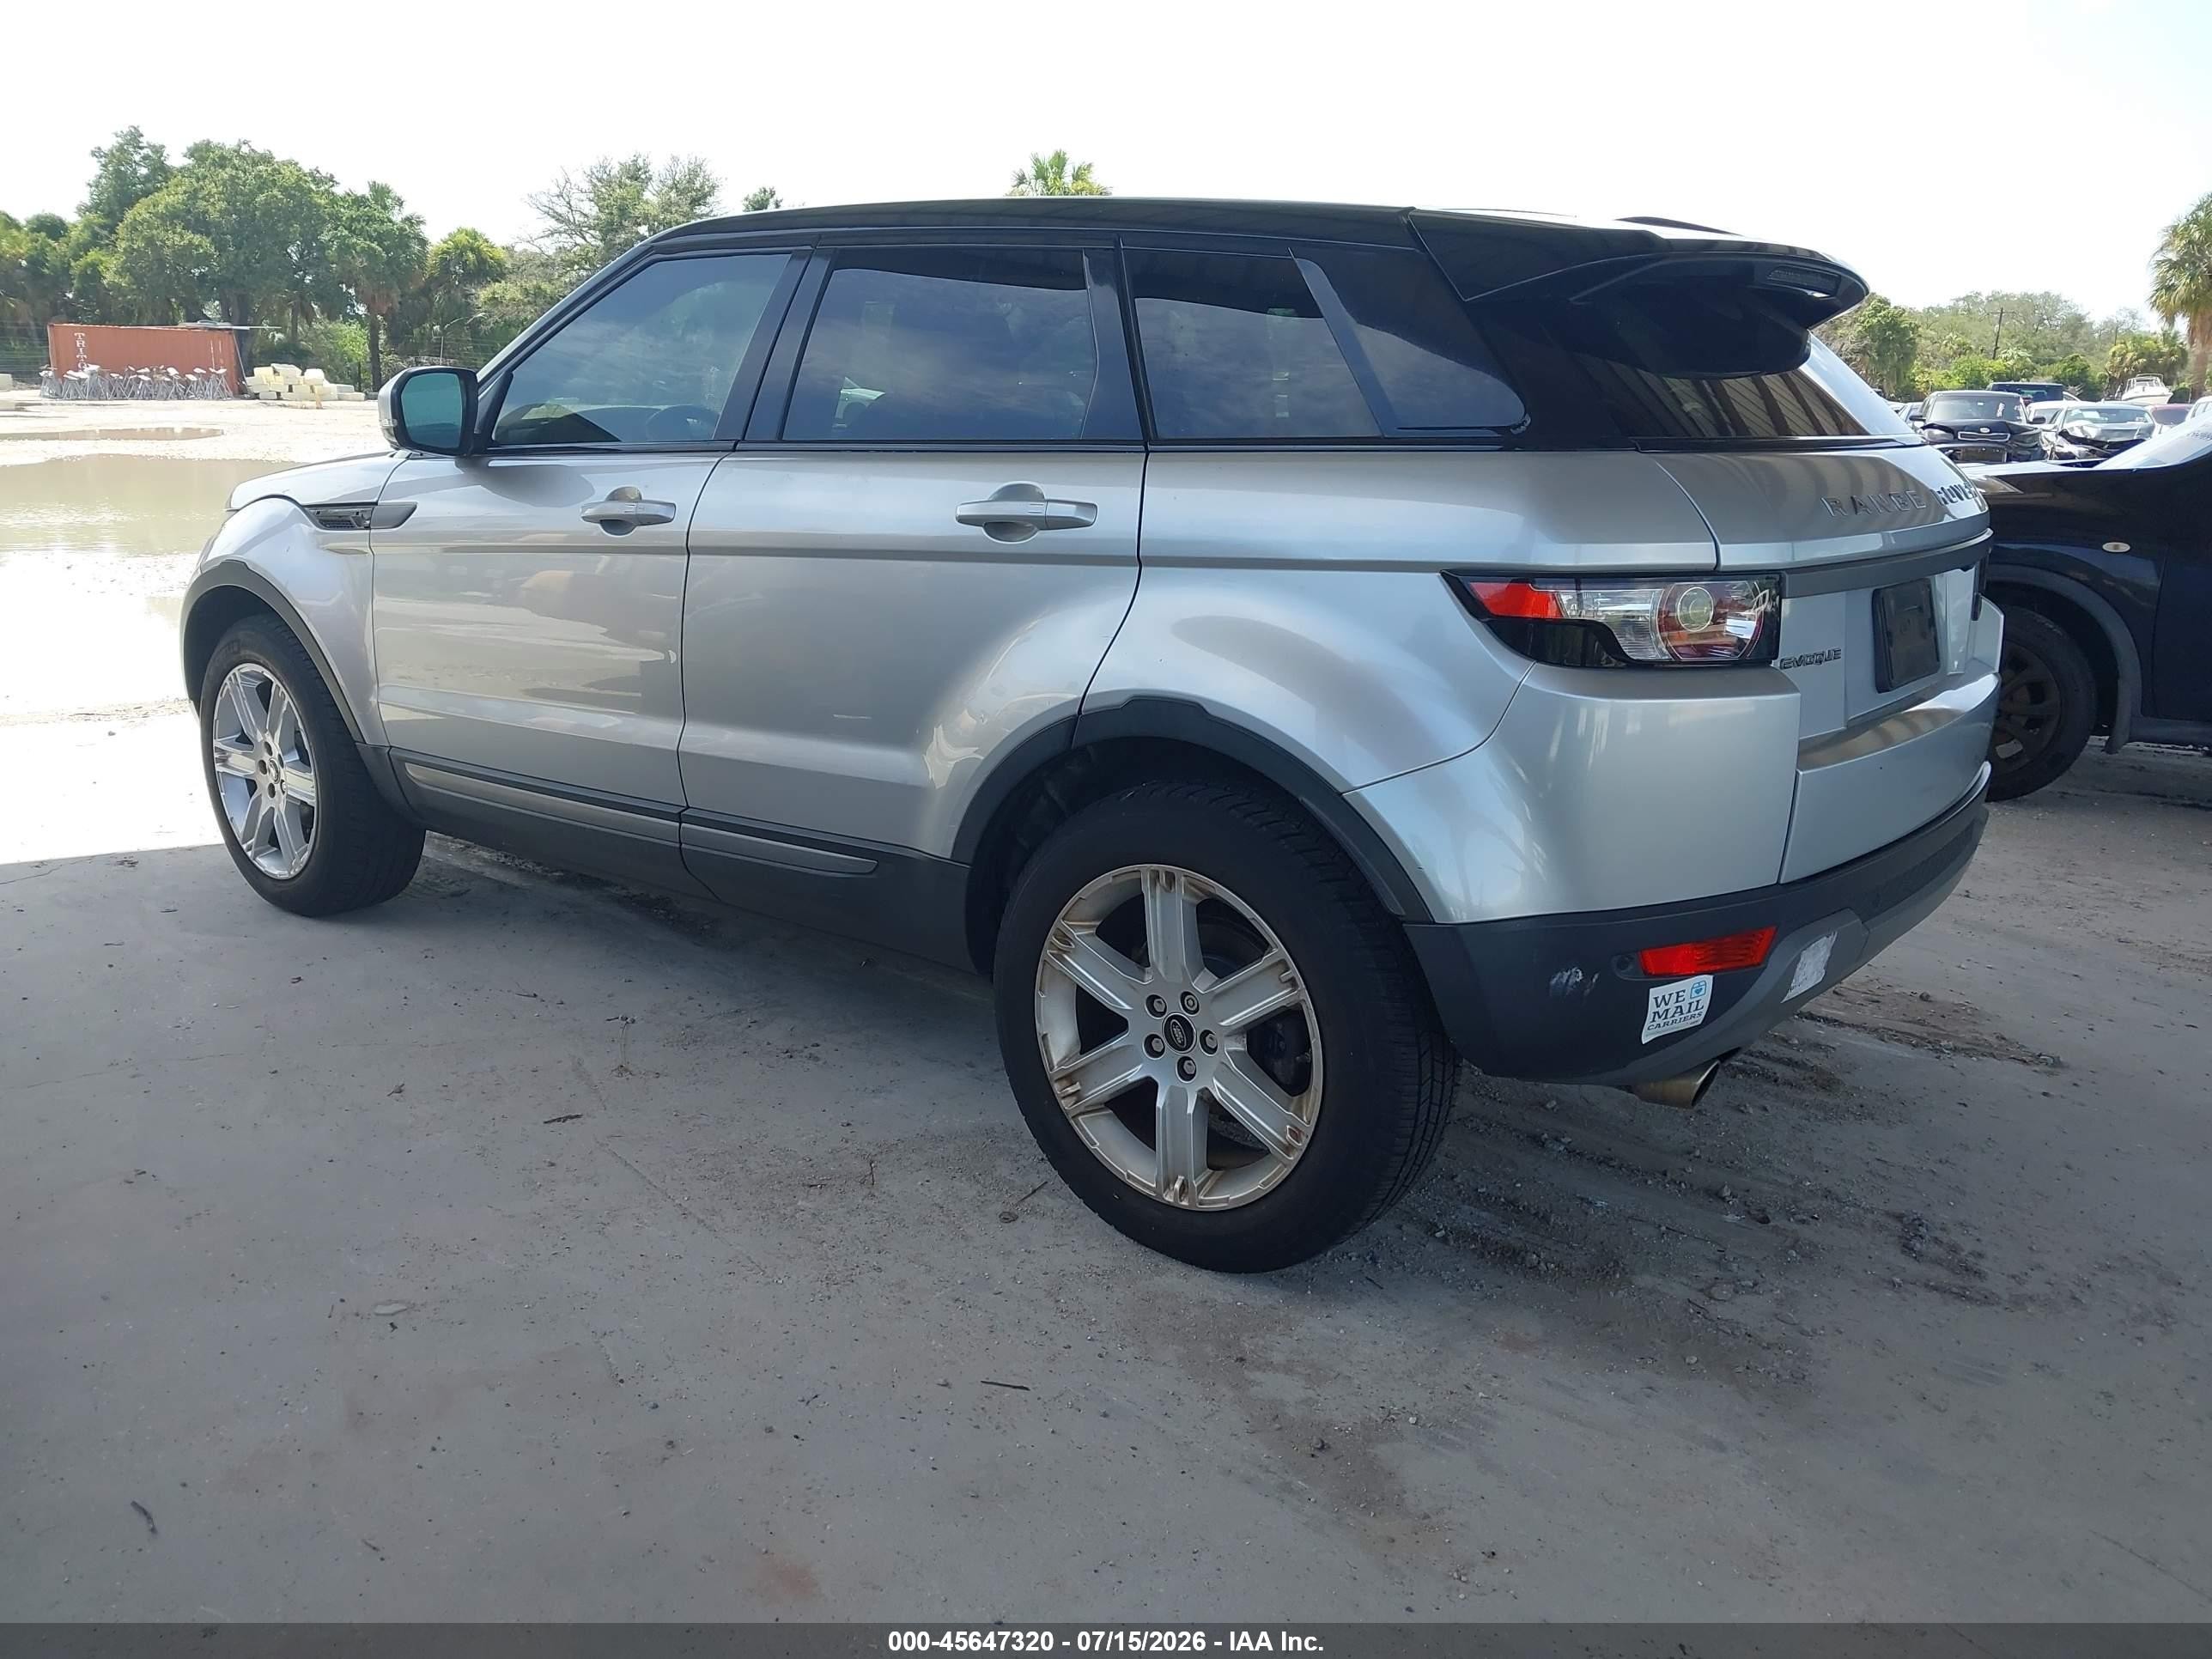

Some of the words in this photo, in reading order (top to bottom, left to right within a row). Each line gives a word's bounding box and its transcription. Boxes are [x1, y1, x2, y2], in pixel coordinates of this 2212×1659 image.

[1820, 490, 1926, 516] RANGE
[1779, 648, 1842, 670] EVOQUE
[1653, 989, 1686, 1008] WE
[1647, 1011, 1704, 1030] CARRIERS
[1650, 999, 1705, 1023] MAIL
